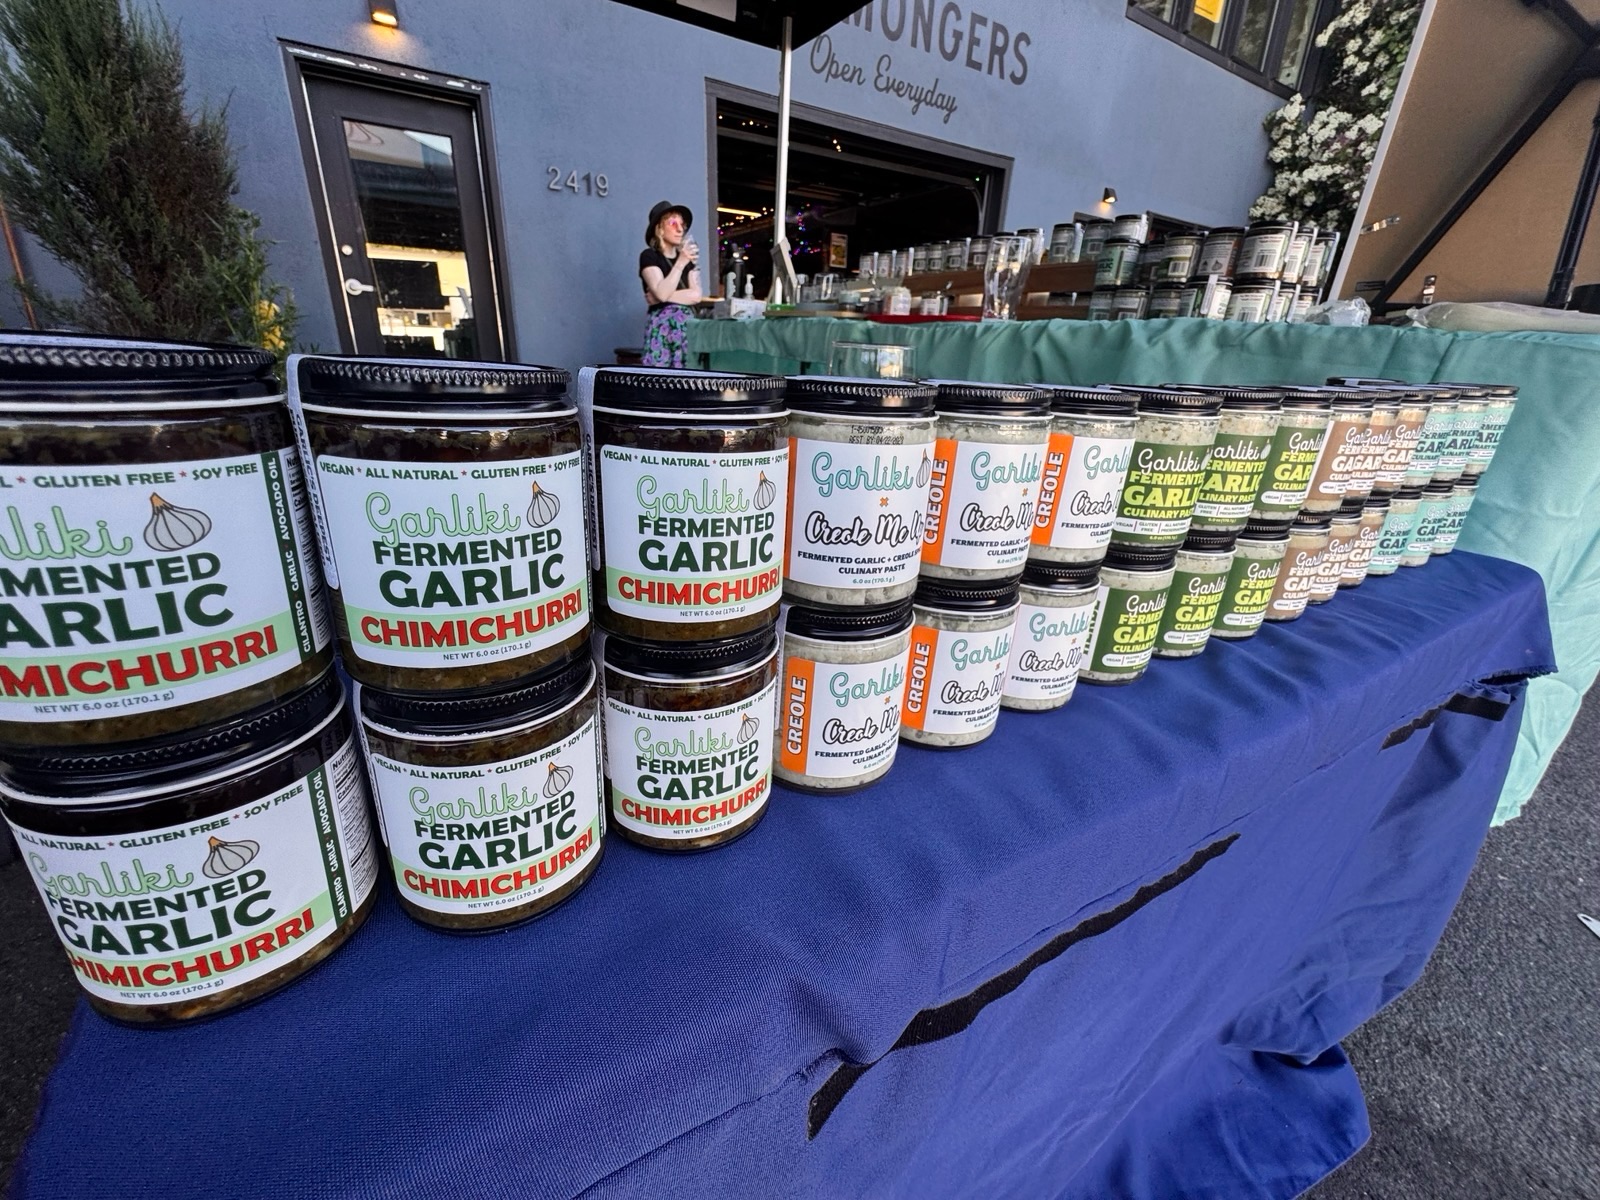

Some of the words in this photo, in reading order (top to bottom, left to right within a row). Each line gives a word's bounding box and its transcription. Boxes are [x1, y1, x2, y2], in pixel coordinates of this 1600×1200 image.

[810, 34, 866, 84] Open
[873, 54, 958, 124] Everyday
[547, 166, 609, 198] 2419
[269, 457, 279, 479] OIL
[320, 460, 355, 476] VEGAN
[365, 467, 390, 479] ALL
[391, 468, 459, 480] NATURAL
[471, 466, 521, 480] GLUTEN
[522, 463, 547, 476] FREE
[554, 459, 568, 472] SOY
[568, 456, 581, 469] FREE
[603, 450, 632, 463] VEGAN
[640, 455, 660, 465] ALL
[661, 457, 711, 467] NATURAL
[719, 457, 753, 468] GLUTEN
[754, 455, 771, 466] FREE
[1137, 447, 1201, 476] Garliki
[1213, 439, 1261, 461] arliki
[34, 473, 122, 489] GLUTEN
[126, 471, 175, 486] FREE
[192, 466, 222, 482] SOY
[226, 462, 258, 478] FREE
[811, 451, 914, 498] Garliki
[1033, 451, 1066, 529] CREOLE
[274, 481, 292, 541] AVOCADO
[636, 474, 750, 521] Garliki
[922, 458, 950, 545] CREOLE
[1070, 489, 1114, 517] Creole
[1123, 506, 1180, 519] CULINARY
[1199, 492, 1239, 503] LINARY
[365, 490, 521, 548] Garliki
[637, 511, 775, 538] FERMENTED
[804, 510, 873, 547] Creole
[959, 502, 1016, 533] Creole
[1060, 521, 1100, 530] FERMENTED
[373, 528, 562, 567] FERMENTED
[638, 532, 774, 572] GARLIC
[797, 550, 853, 564] FERMENTED
[854, 556, 886, 565] GARLIC
[950, 538, 1000, 548] FERMENTED
[1000, 539, 1021, 547] GARLIC
[987, 548, 1018, 557] CULINARY
[283, 550, 301, 592] GARLIC
[379, 553, 566, 609] GARLIC
[617, 565, 781, 606] CHIMICHURRI
[838, 566, 883, 575] CULINARY
[884, 563, 907, 574] PASTE
[295, 600, 312, 653] CILANTRO
[360, 588, 583, 648] CHIMICHURRI
[443, 652, 459, 661] NET
[461, 651, 474, 660] WT
[476, 649, 489, 658] 6.0
[1018, 649, 1065, 673] Creole
[907, 643, 932, 714] CREOLE
[940, 680, 989, 705] Creole
[1011, 675, 1051, 683] FERMENTED
[34, 704, 58, 715] NET
[60, 703, 81, 714] WT
[82, 701, 103, 712] 6.0
[104, 701, 121, 710] oz
[608, 700, 631, 716] VEGAN
[637, 711, 652, 721] ALL
[654, 714, 696, 723] NATURAL
[703, 708, 736, 721] GLUTEN
[736, 699, 754, 714] FREE
[786, 676, 808, 756] CREOLE
[932, 709, 976, 717] FERMENTED
[634, 726, 734, 763] Garliki
[815, 748, 864, 758] FERMENTED
[865, 741, 887, 754] GARLIC
[822, 717, 879, 745] Creole
[374, 756, 402, 774] VEGAN
[409, 768, 429, 779] ALL
[431, 769, 485, 780] NATURAL
[495, 756, 538, 775] GLUTEN
[540, 746, 562, 762] FREE
[567, 734, 581, 748] SOY
[581, 721, 594, 736] FREE
[635, 739, 760, 776] FERMENTED
[852, 750, 885, 765] CULINARY
[314, 769, 324, 790] OIL
[636, 755, 760, 801] GARLIC
[20, 832, 40, 849] ALL
[39, 837, 106, 852] NATURAL
[119, 828, 187, 850] GLUTEN
[189, 816, 230, 837] FREE
[243, 800, 271, 820] SOY
[273, 784, 305, 808] FREE
[317, 790, 333, 835] AVOCADO
[408, 782, 538, 827] Garliki
[413, 790, 576, 842] FERMENTED
[621, 773, 769, 827] CHIMICHURRI
[326, 842, 340, 873] GARLIC
[418, 808, 578, 871] GARLIC
[28, 851, 195, 900] Garliki
[403, 827, 593, 899] CHIMICHURRI
[45, 868, 267, 923] FERMENTED
[332, 873, 349, 919] CILANTRO
[467, 902, 482, 910] NET
[482, 901, 495, 909] WT
[495, 898, 507, 906] 6.0
[57, 889, 276, 957] GARLIC
[120, 990, 137, 999] NET
[137, 990, 152, 999] WT
[152, 988, 168, 998] 6.0
[168, 988, 182, 997] oz
